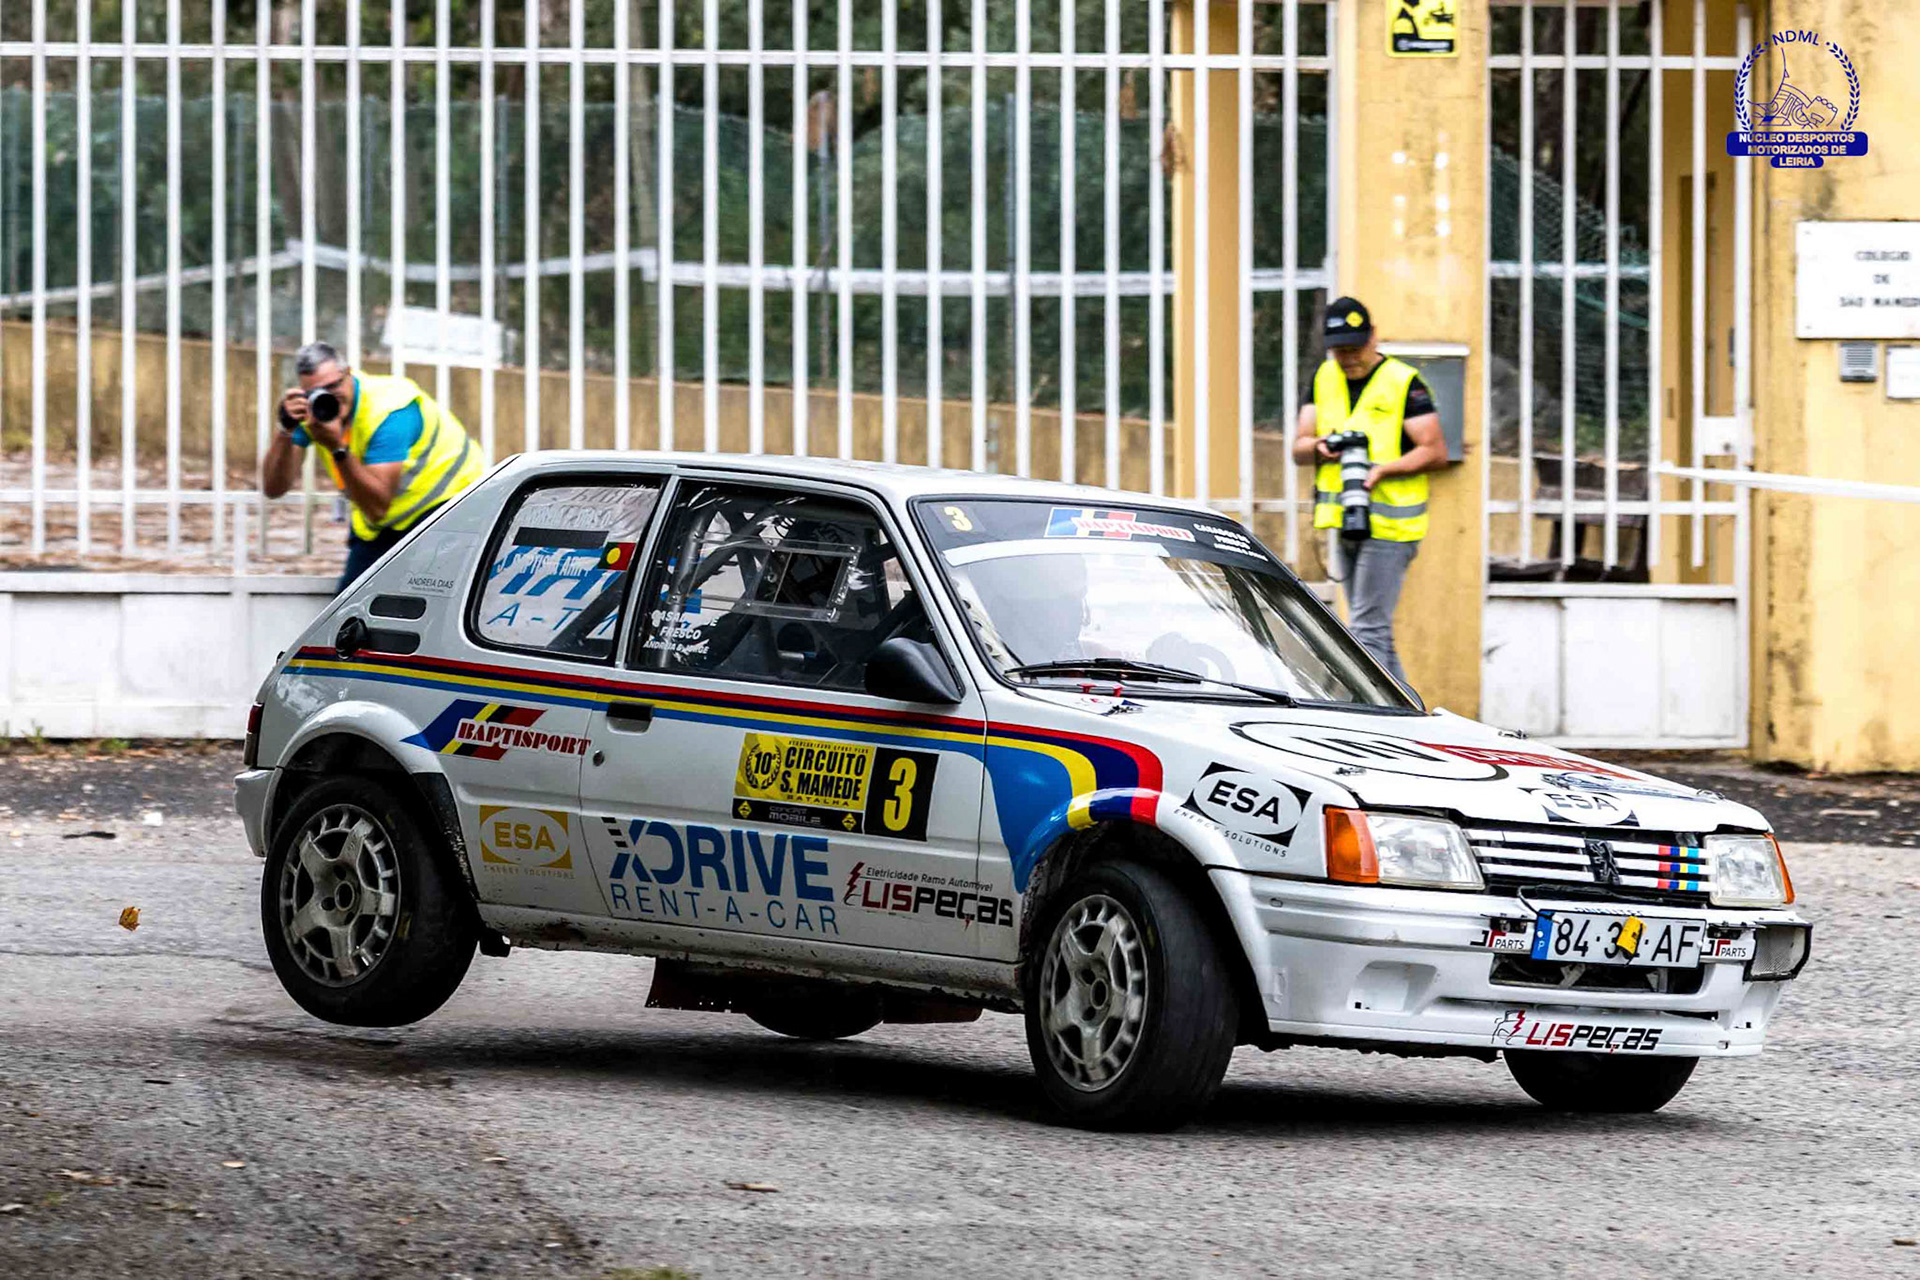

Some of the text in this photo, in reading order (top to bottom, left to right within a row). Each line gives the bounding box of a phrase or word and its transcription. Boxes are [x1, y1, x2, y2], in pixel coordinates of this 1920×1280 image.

[944, 506, 974, 532] 3
[437, 579, 455, 589] DIAS
[659, 626, 702, 640] FRESCO
[784, 746, 866, 776] CIRCUITO
[780, 770, 862, 801] S. MAMEDE
[883, 757, 918, 831] 3
[786, 794, 850, 807] BATALHA
[1207, 779, 1280, 825] ESA
[494, 822, 556, 852] ESA
[1223, 830, 1288, 858] SOLUTIONS
[866, 867, 919, 882] Eletricidade
[921, 873, 946, 886] Ramo
[609, 883, 840, 935] RENT-A-CAR
[1494, 938, 1526, 950] PARTS
[1720, 947, 1747, 957] PARTS
